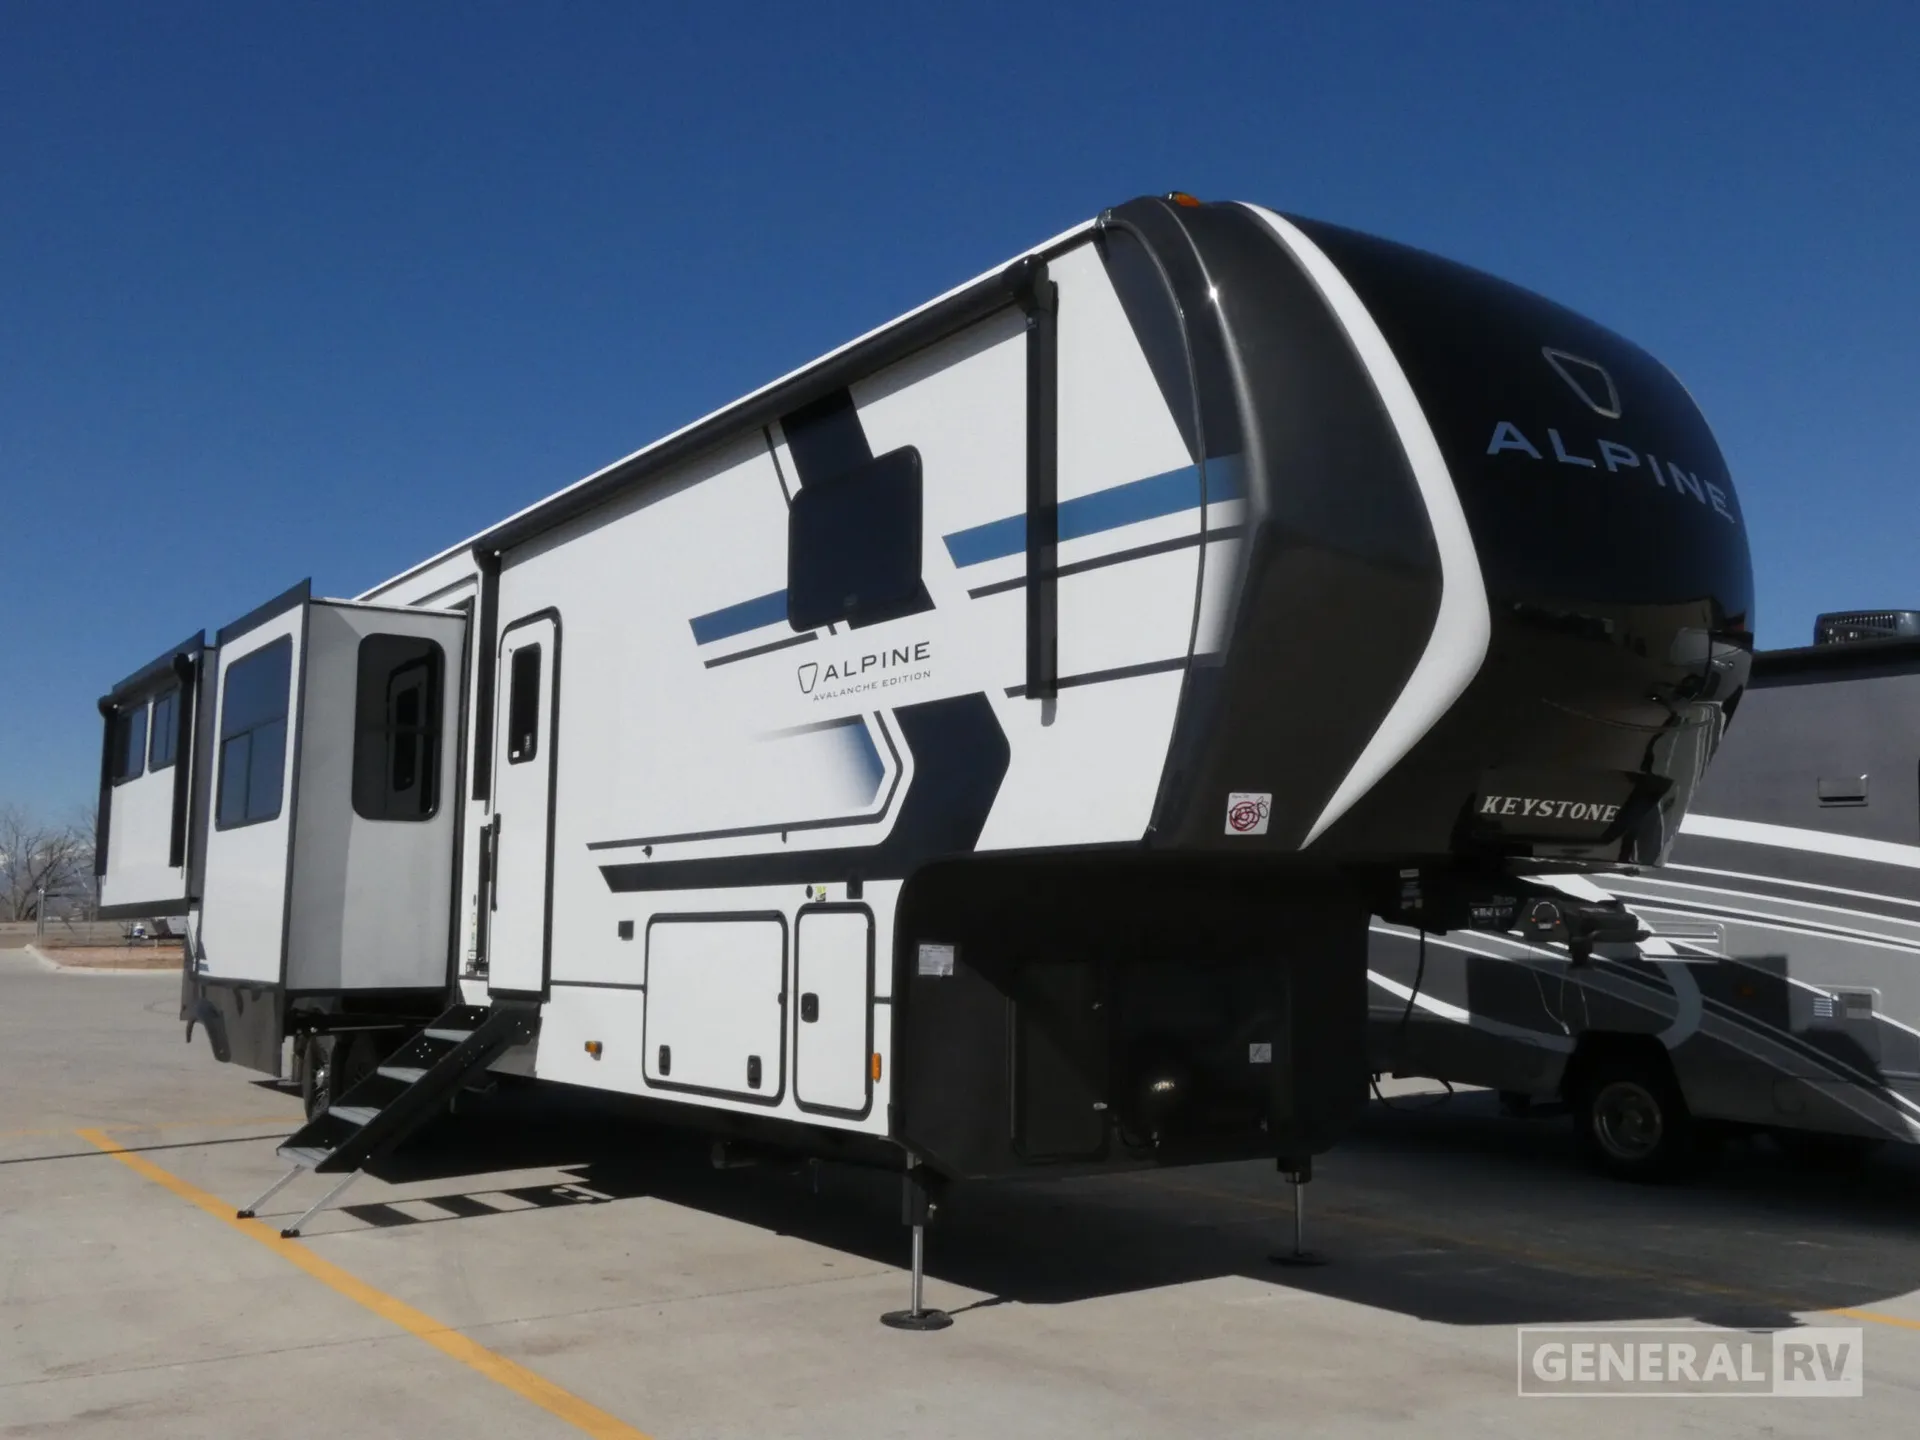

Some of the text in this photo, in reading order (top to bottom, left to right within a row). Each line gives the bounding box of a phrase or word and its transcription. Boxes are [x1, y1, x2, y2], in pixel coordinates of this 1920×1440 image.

[1486, 421, 1735, 524] ALPINE
[823, 641, 931, 682] ALPINE
[813, 670, 931, 702] AVALANCHE EDITION
[1480, 796, 1620, 822] KEYSTONE
